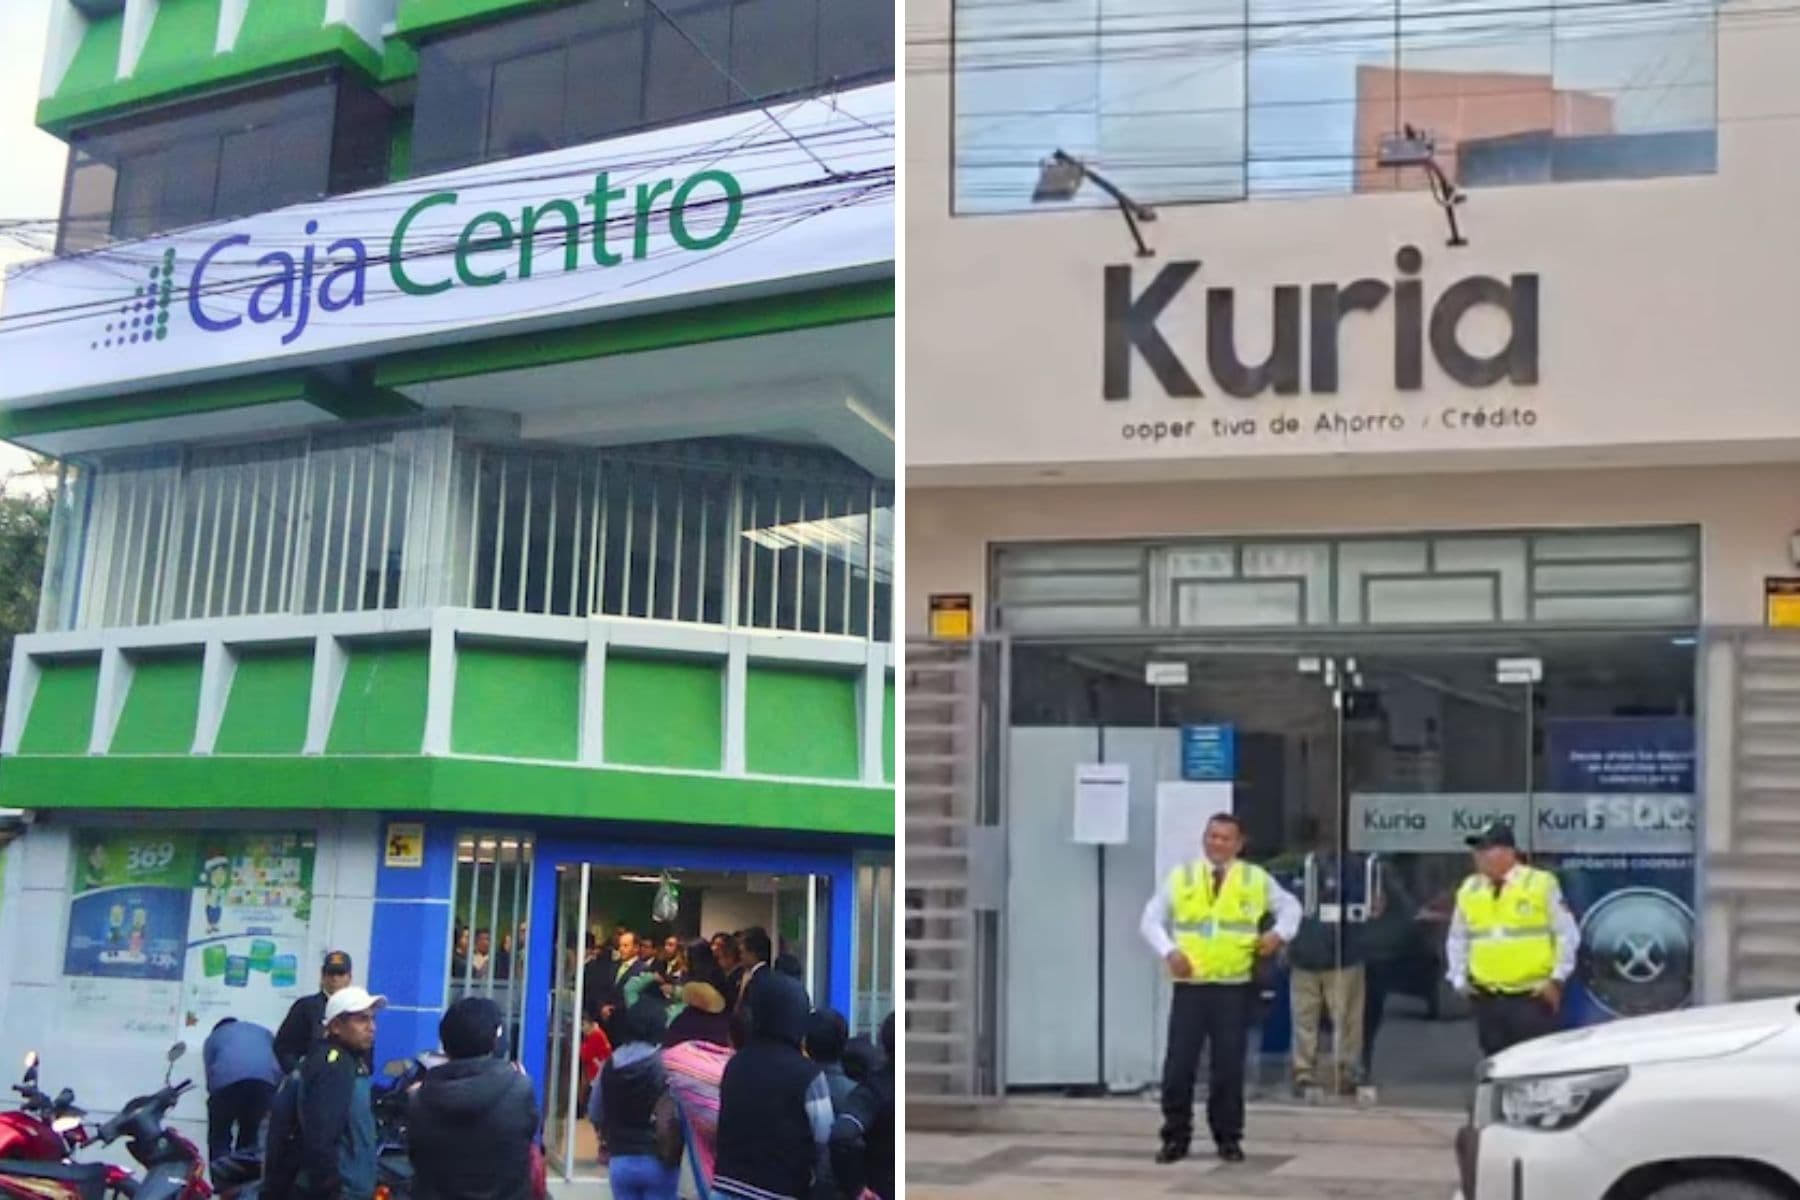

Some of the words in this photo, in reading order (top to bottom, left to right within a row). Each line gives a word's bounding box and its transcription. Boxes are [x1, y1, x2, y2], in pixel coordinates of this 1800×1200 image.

[188, 219, 368, 345] Caja
[389, 168, 743, 296] Centro
[1103, 245, 1540, 401] Kuria
[1269, 412, 1300, 435] de
[1314, 411, 1405, 438] Ahorro
[1364, 807, 1426, 831] Kuria
[124, 841, 176, 870] 369
